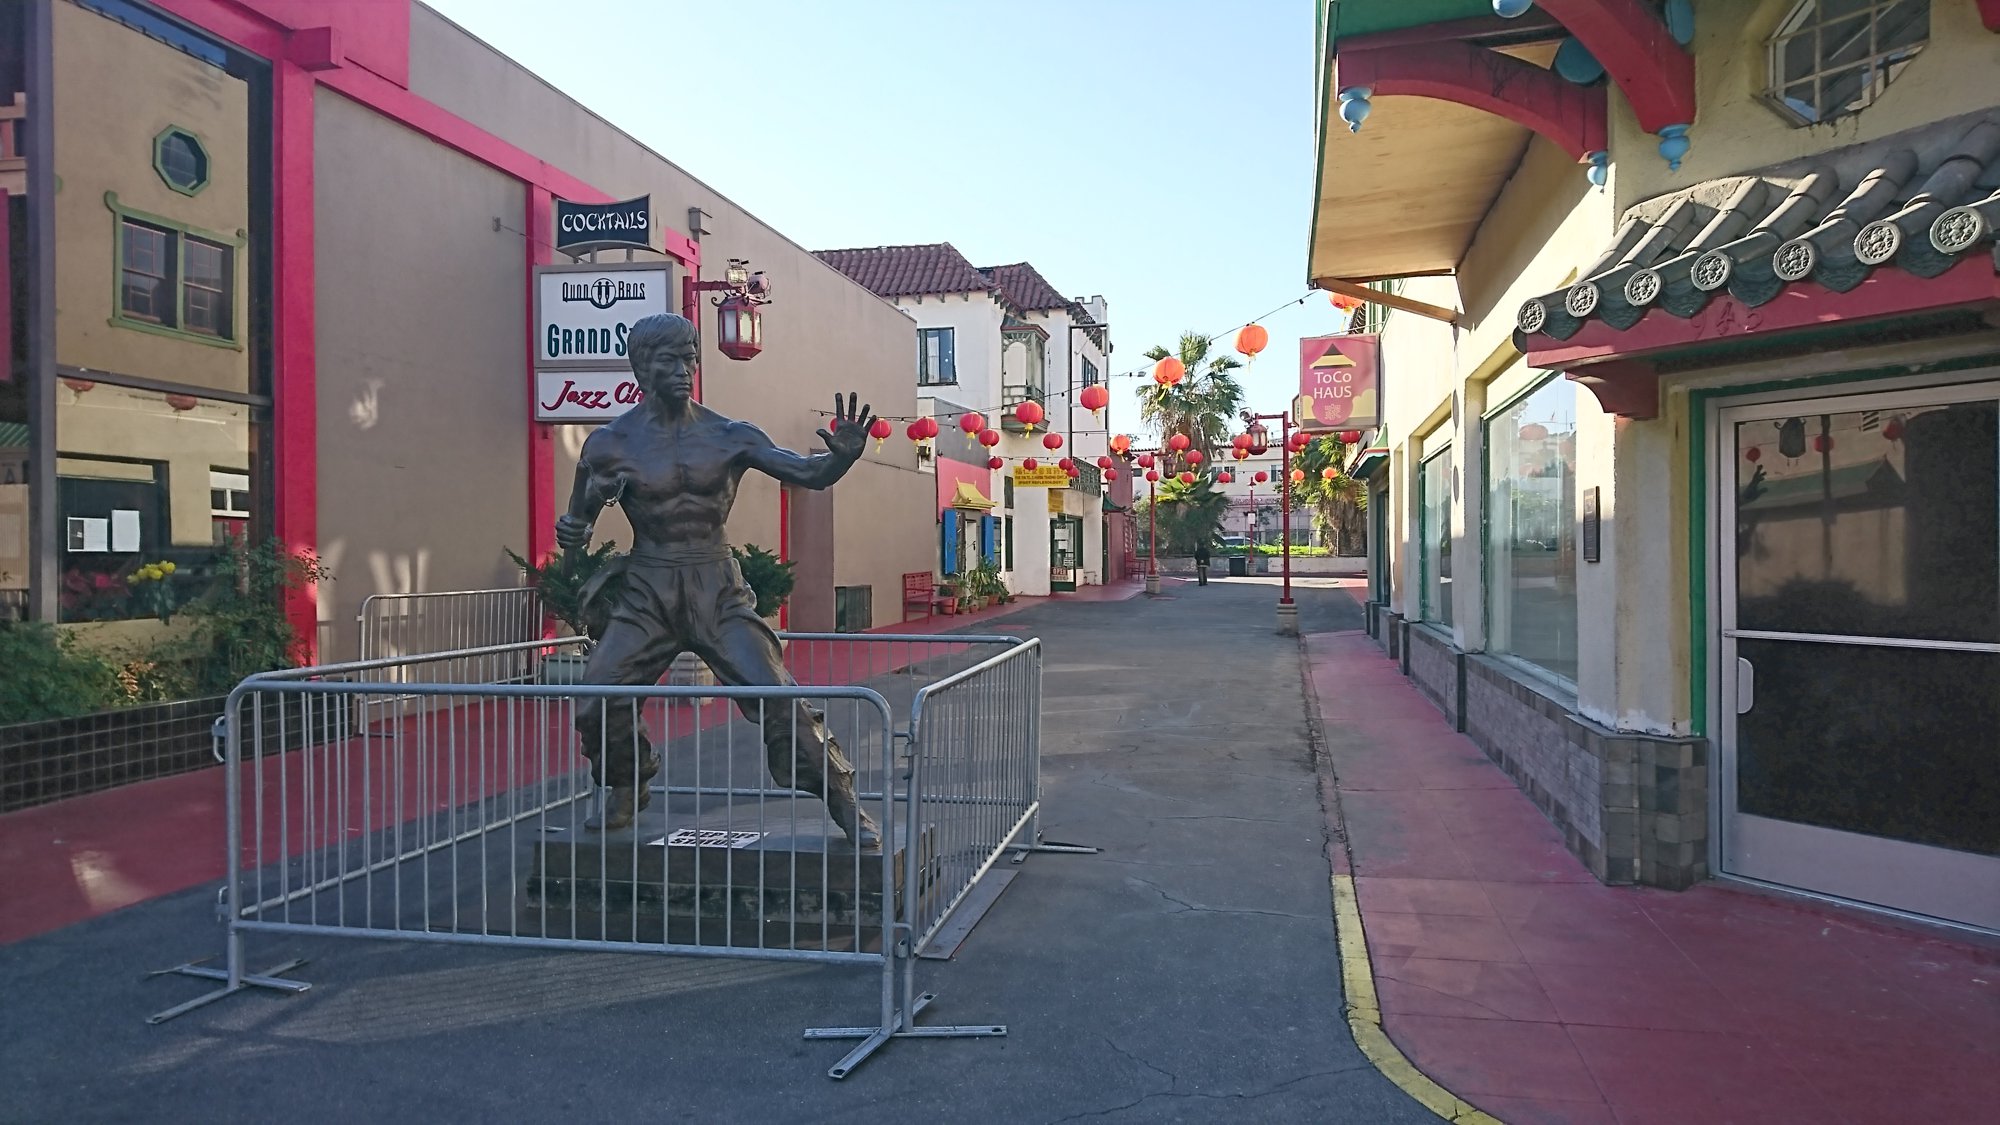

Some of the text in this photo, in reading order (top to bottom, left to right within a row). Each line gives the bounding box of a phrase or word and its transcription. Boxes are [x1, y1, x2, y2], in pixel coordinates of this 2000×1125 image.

[561, 210, 648, 232] COCKTAILS
[617, 280, 646, 301] BROS
[547, 323, 611, 358] GRAND
[1314, 371, 1352, 384] ToCo
[541, 380, 612, 411] Jazz
[1313, 386, 1352, 399] HAUS
